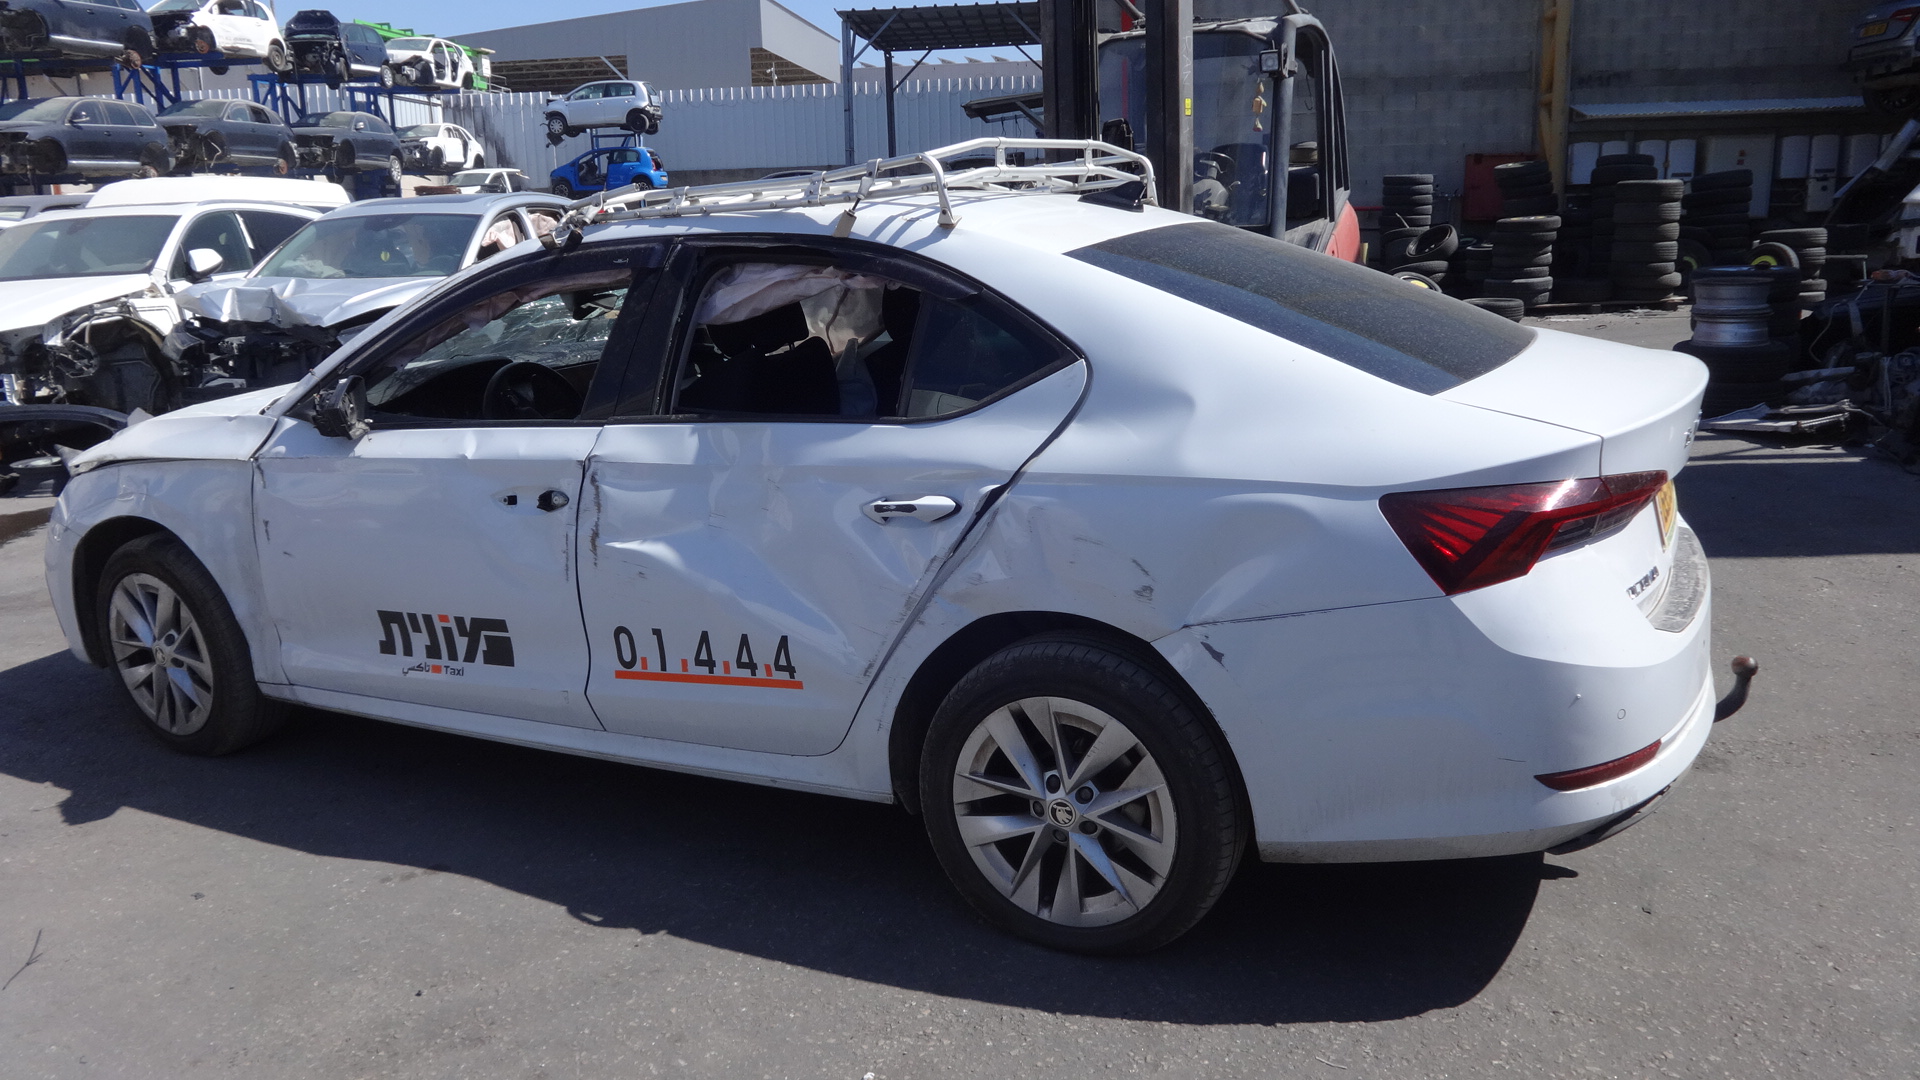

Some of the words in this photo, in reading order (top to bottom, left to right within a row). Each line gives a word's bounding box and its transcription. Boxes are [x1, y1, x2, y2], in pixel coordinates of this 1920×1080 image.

[376, 609, 516, 668] מונית
[402, 662, 431, 676] تاكسي
[443, 665, 465, 677] Taxi
